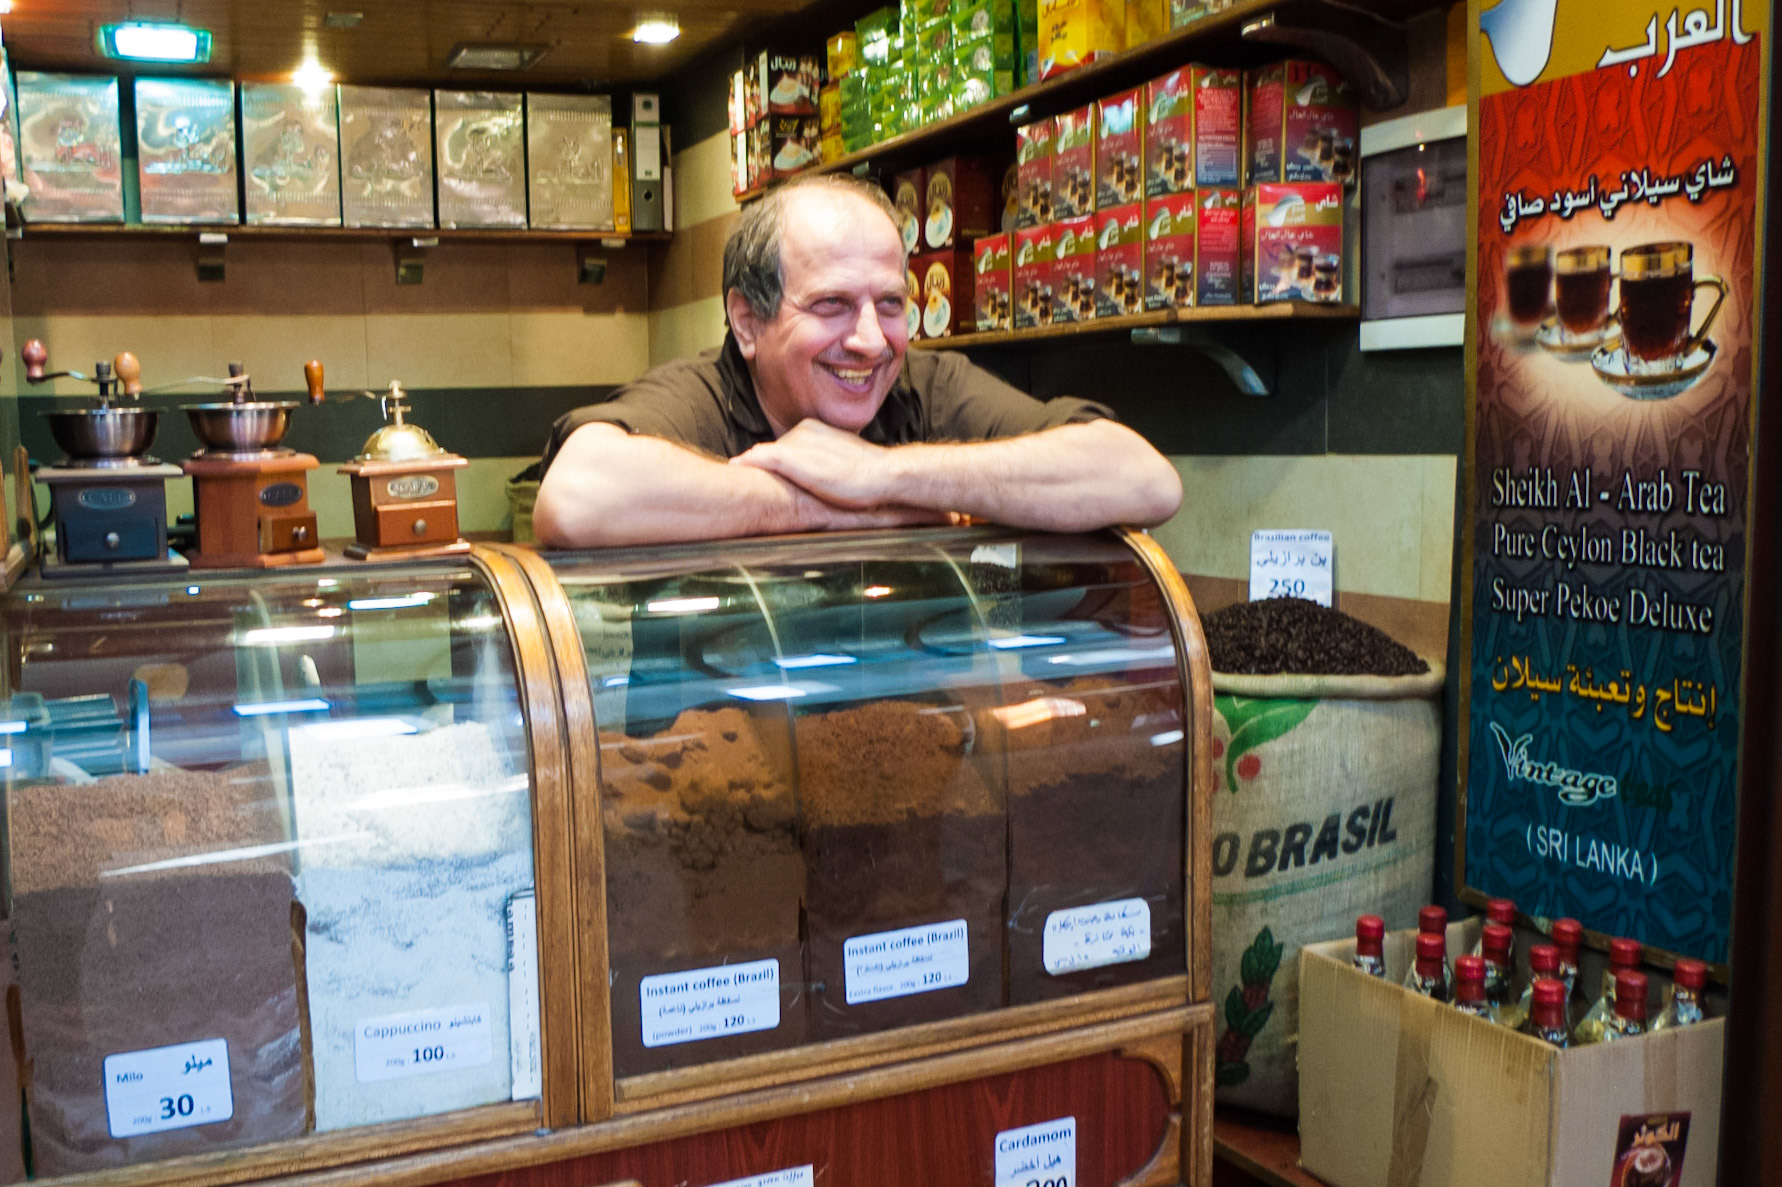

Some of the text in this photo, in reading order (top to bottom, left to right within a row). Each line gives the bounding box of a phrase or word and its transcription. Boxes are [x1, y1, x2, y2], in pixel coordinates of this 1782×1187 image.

[1315, 194, 1338, 212] شاي
[1500, 156, 1734, 232] شاي سيلاني أسود صافي
[1492, 467, 1558, 507] Sheikh
[1566, 467, 1590, 508] Al
[1618, 469, 1672, 512] Arab
[1682, 470, 1725, 514] Tea
[1493, 523, 1724, 571] Pure Ceylon Black tea
[1269, 578, 1305, 597] 250
[1492, 577, 1712, 633] Super Pekoe Deluxe
[1492, 655, 1716, 731] إنتاج وتعبئة سيلان
[1490, 720, 1617, 806] Vintage
[1245, 796, 1397, 879] BRASIL
[848, 927, 964, 957] Instant coffee (Brazil)
[646, 967, 774, 998] Instant coffee (Brazil)
[923, 971, 942, 986] 120
[364, 1020, 442, 1040] Cappuccino
[724, 1014, 745, 1029] 120
[182, 1053, 213, 1076] ميلو
[413, 1045, 444, 1064] 100
[116, 1071, 144, 1084] Milo
[160, 1093, 194, 1120] 30
[1000, 1128, 1072, 1153] Cardamom
